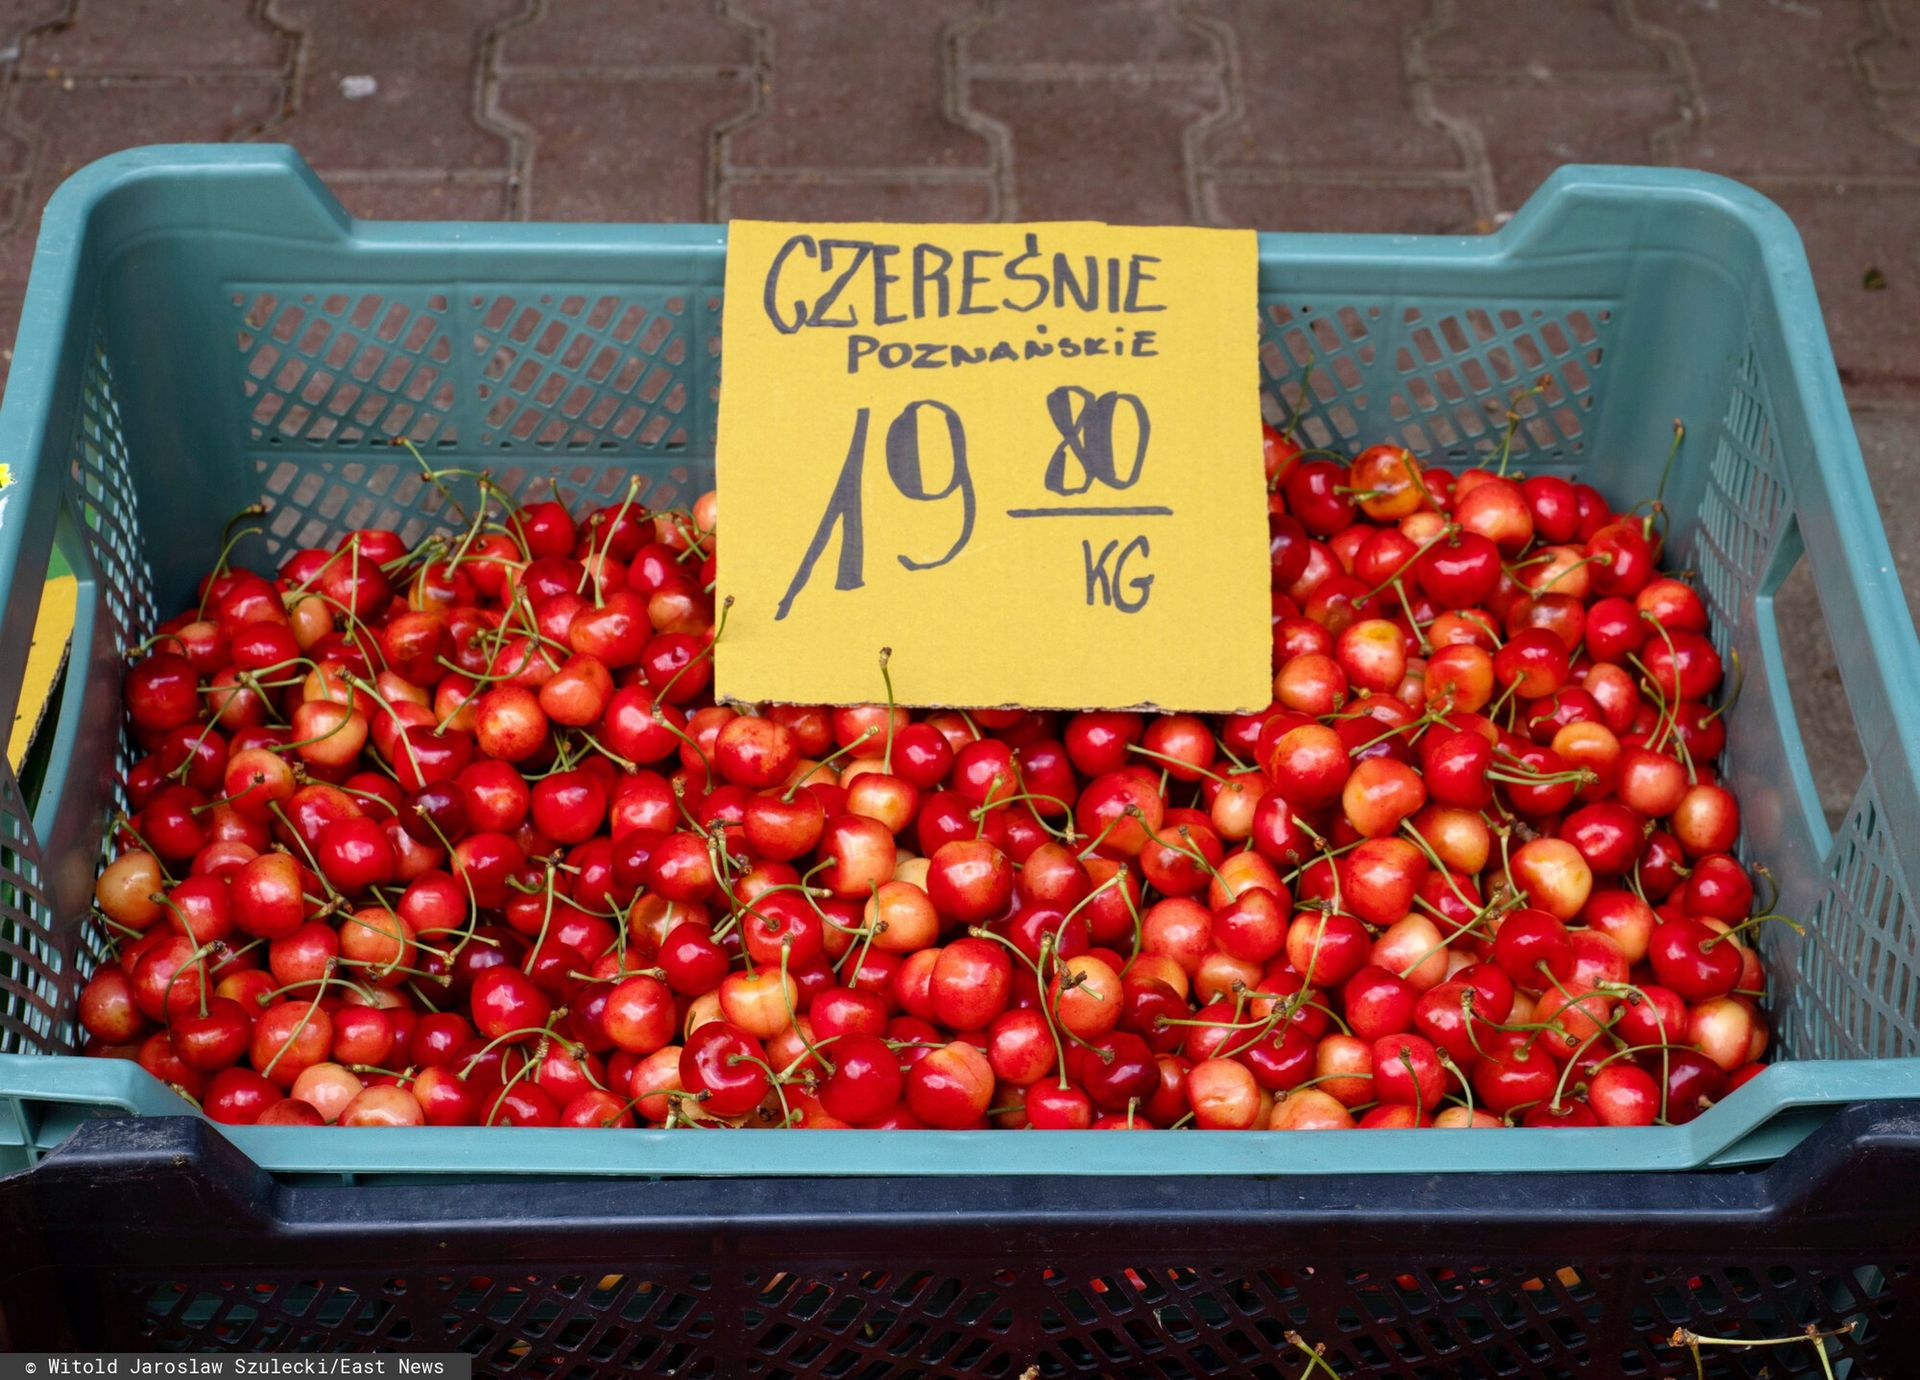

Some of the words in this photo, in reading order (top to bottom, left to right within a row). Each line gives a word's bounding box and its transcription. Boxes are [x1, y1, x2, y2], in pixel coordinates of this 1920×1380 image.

[763, 233, 1168, 335] CZEREŚNIE
[774, 399, 977, 621] 19
[1044, 385, 1151, 497] 80
[1082, 535, 1155, 613] KG
